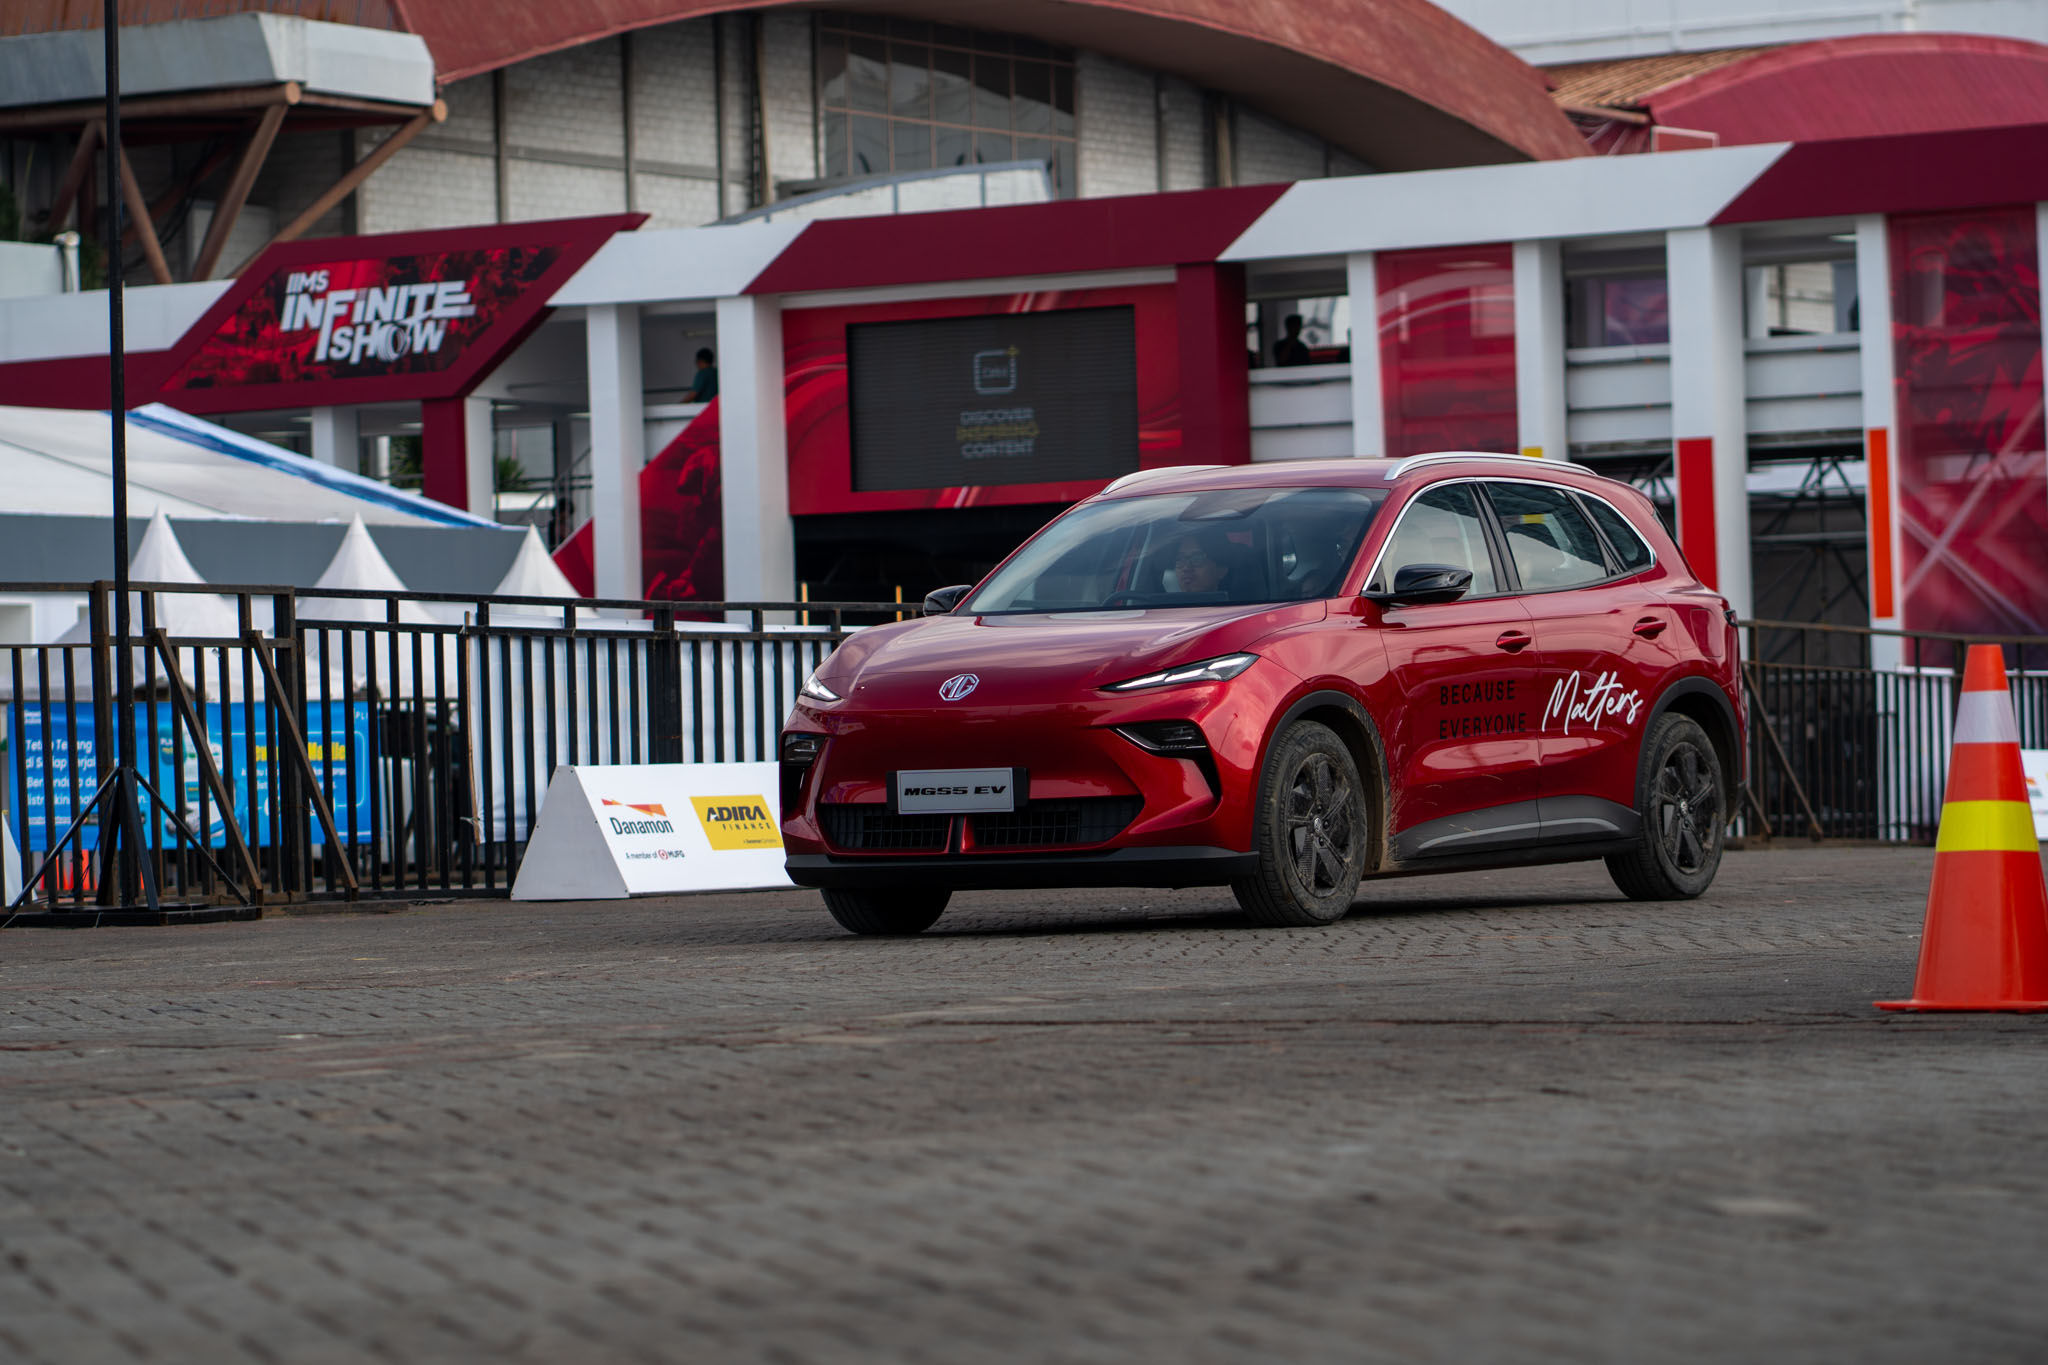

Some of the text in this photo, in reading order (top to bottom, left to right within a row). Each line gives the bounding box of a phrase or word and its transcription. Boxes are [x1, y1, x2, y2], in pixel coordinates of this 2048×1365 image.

[286, 269, 330, 294] IIMS
[280, 280, 477, 362] INFINITE
[329, 318, 449, 364] SHOW
[960, 408, 1034, 425] DISCOVER
[961, 439, 1034, 458] CONTENT
[941, 674, 978, 699] MG
[1440, 680, 1516, 706] BECAUSE
[1541, 670, 1644, 735] Matters
[1439, 713, 1527, 740] EVERYONE
[904, 785, 1007, 797] MGS5 EV
[610, 817, 674, 836] Danamon
[706, 805, 767, 823] ADIRA
[722, 822, 772, 831] FINANCE
